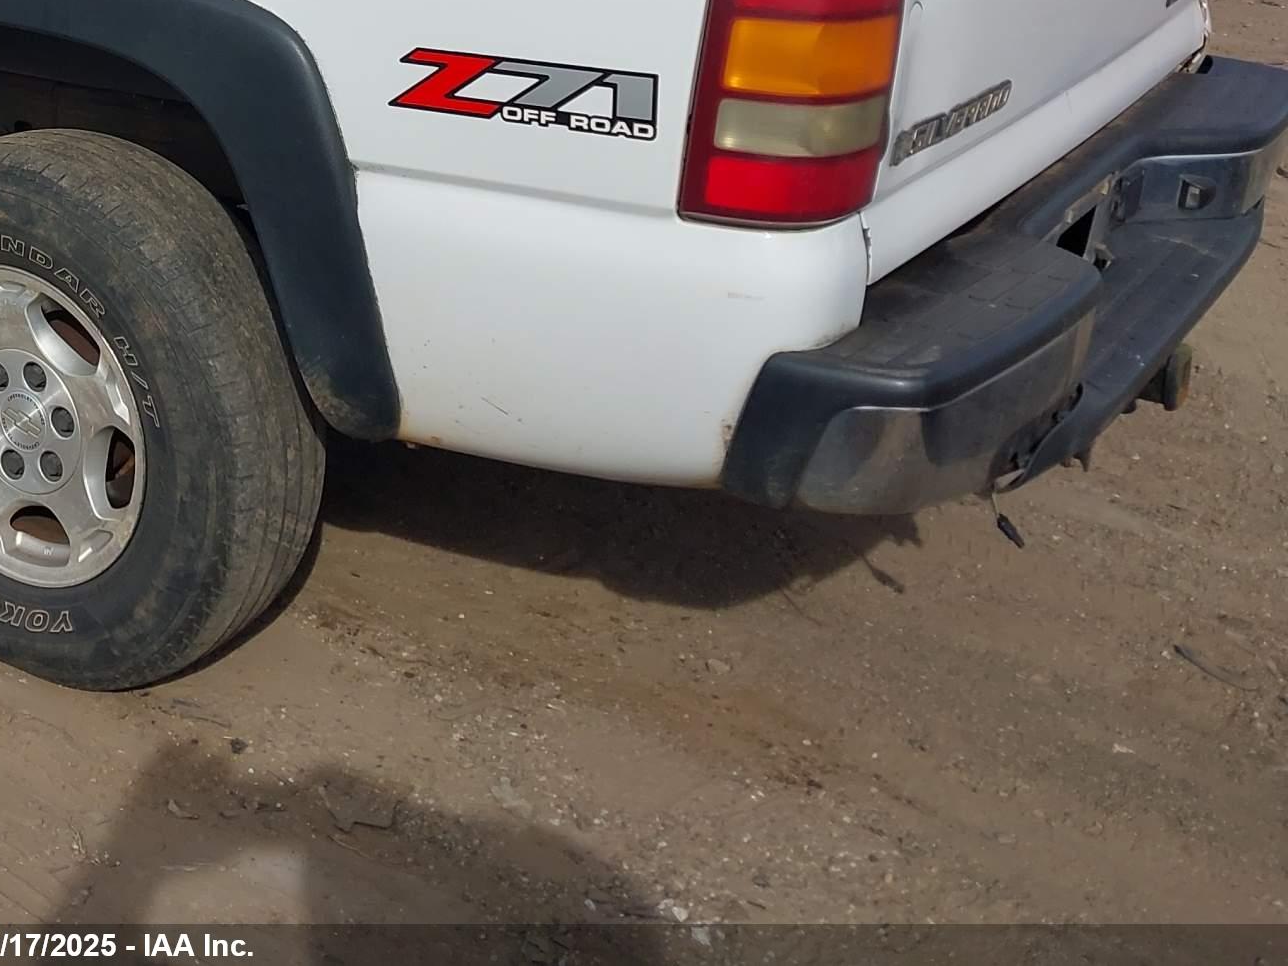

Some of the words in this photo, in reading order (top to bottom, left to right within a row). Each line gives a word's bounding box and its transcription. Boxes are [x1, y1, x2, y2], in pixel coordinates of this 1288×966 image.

[388, 47, 660, 121] Z71
[501, 105, 557, 125] OFF
[569, 114, 656, 140] ROAD
[113, 335, 161, 429] H/T
